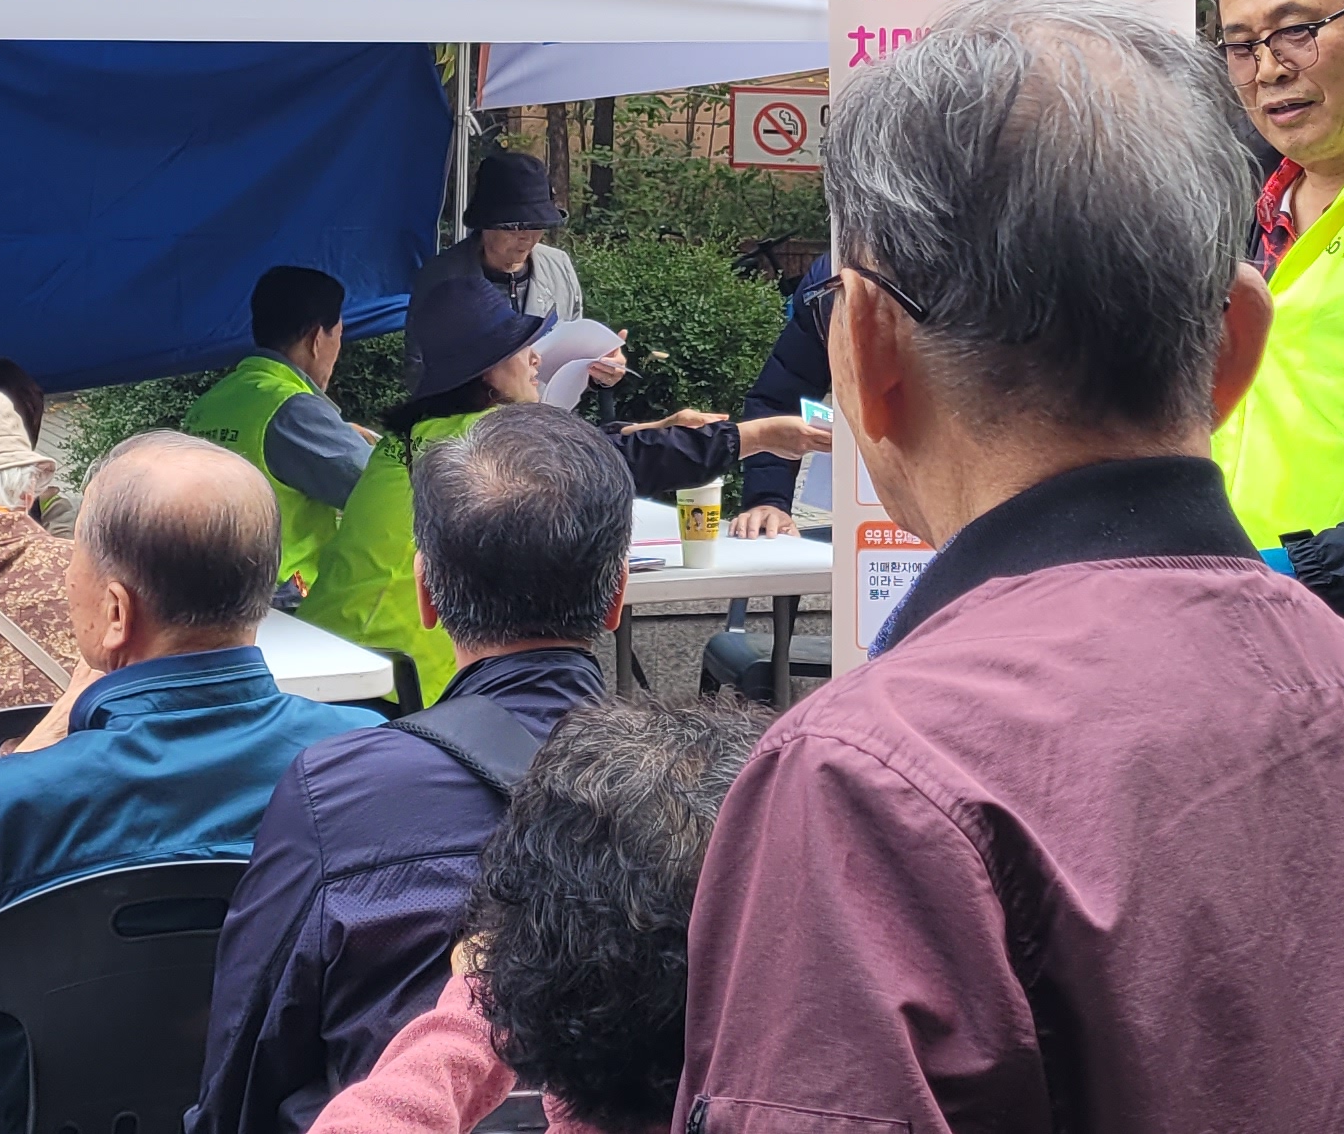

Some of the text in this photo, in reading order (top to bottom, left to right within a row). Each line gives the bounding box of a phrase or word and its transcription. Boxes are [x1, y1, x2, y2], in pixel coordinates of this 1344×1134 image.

[864, 529, 882, 545] 우유
[869, 575, 904, 587] 이라는
[869, 589, 891, 601] 풍부
